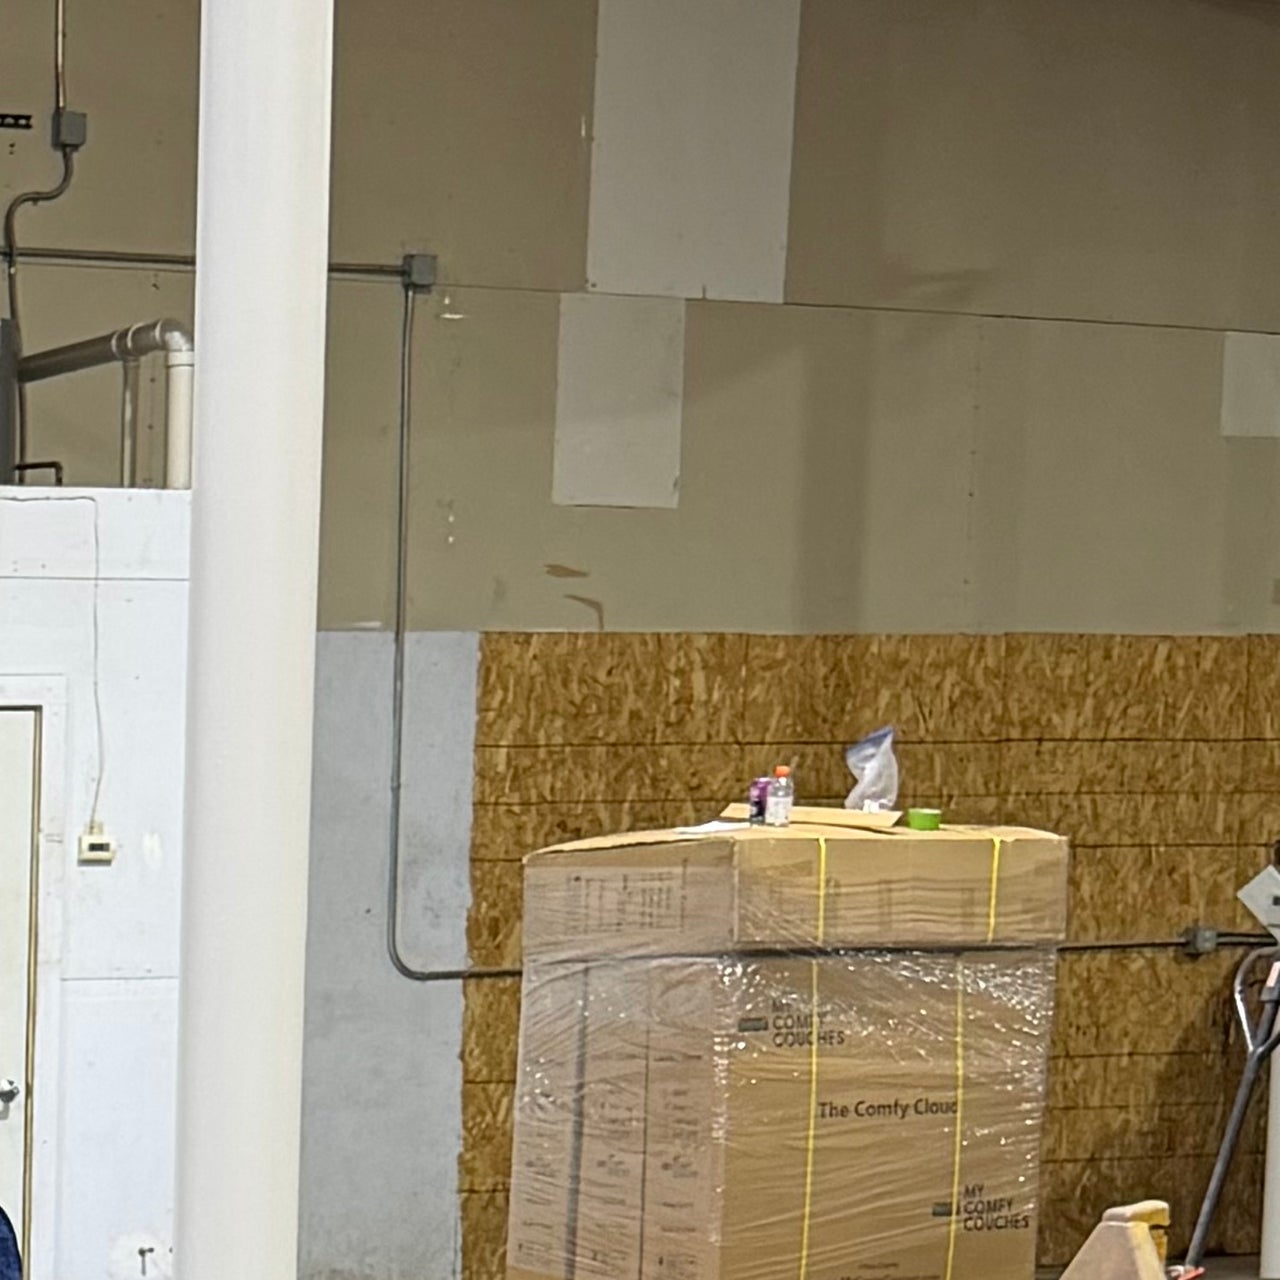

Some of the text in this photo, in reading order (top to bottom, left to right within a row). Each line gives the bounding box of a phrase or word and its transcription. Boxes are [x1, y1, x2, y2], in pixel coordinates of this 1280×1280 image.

[772, 1013, 828, 1031] COMY
[818, 1102, 849, 1119] The
[854, 1099, 910, 1120] Comfy
[964, 1184, 985, 1199] MY
[964, 1198, 1014, 1215] COMFY
[964, 1214, 1030, 1232] COUCHES
